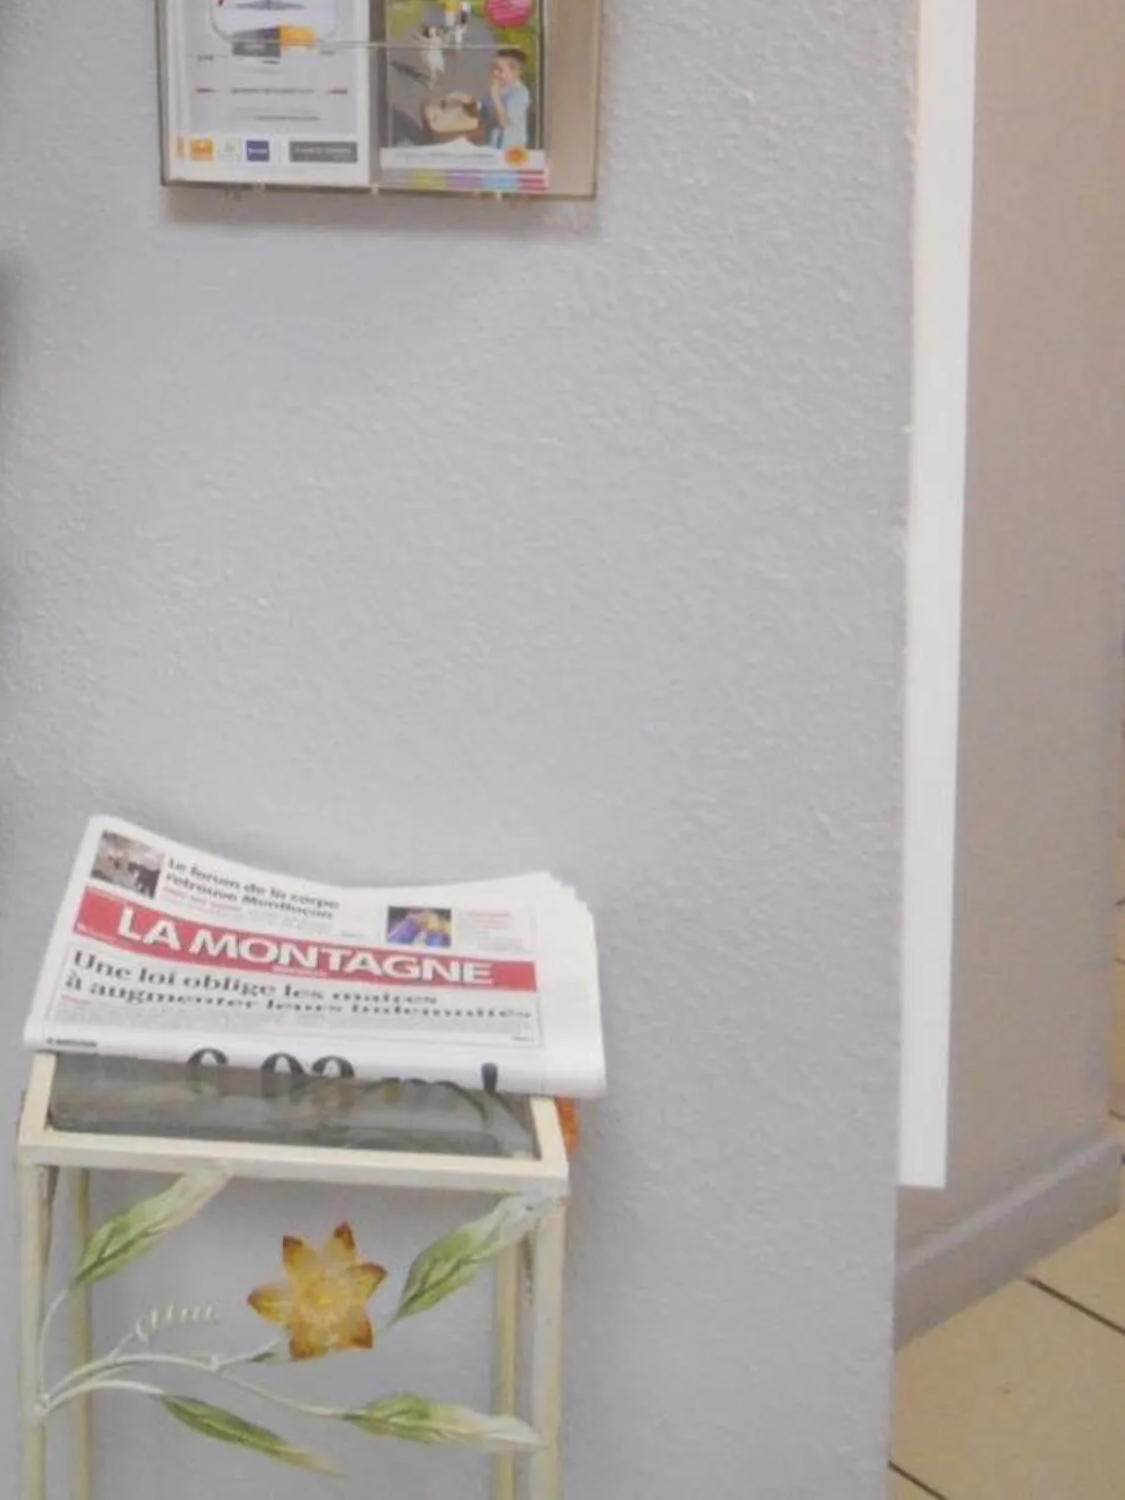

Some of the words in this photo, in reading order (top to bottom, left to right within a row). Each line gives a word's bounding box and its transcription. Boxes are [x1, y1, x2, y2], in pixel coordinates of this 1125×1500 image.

[116, 905, 181, 950] LA
[188, 928, 494, 986] MONTAGNE
[65, 969, 82, 991] à
[89, 976, 261, 1011] augmenter
[74, 950, 132, 981] Une
[139, 966, 176, 987] loi
[183, 970, 276, 998] oblige
[285, 981, 324, 1000] les
